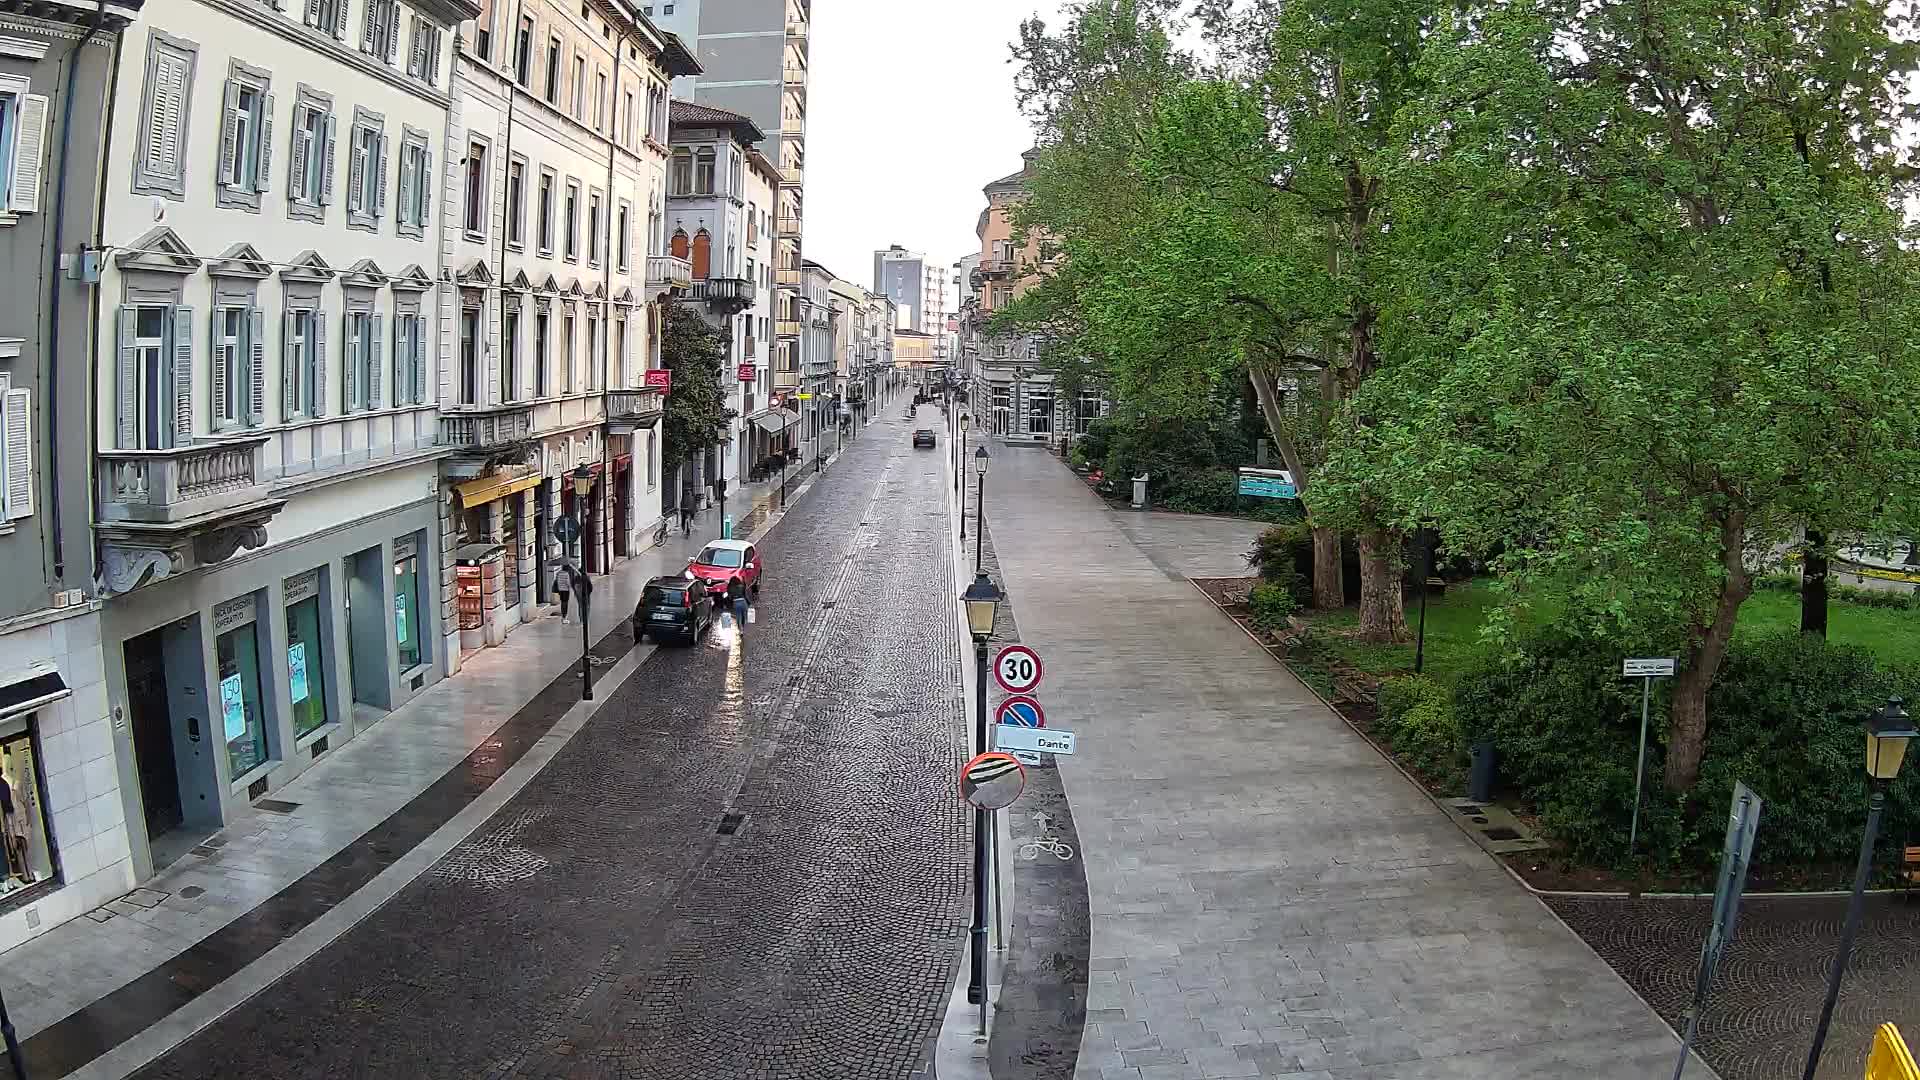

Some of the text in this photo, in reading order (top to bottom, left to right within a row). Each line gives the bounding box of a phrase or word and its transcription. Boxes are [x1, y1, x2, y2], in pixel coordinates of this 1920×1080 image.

[1004, 658, 1034, 681] 30
[219, 678, 240, 701] 130
[1038, 738, 1070, 750] Dante
